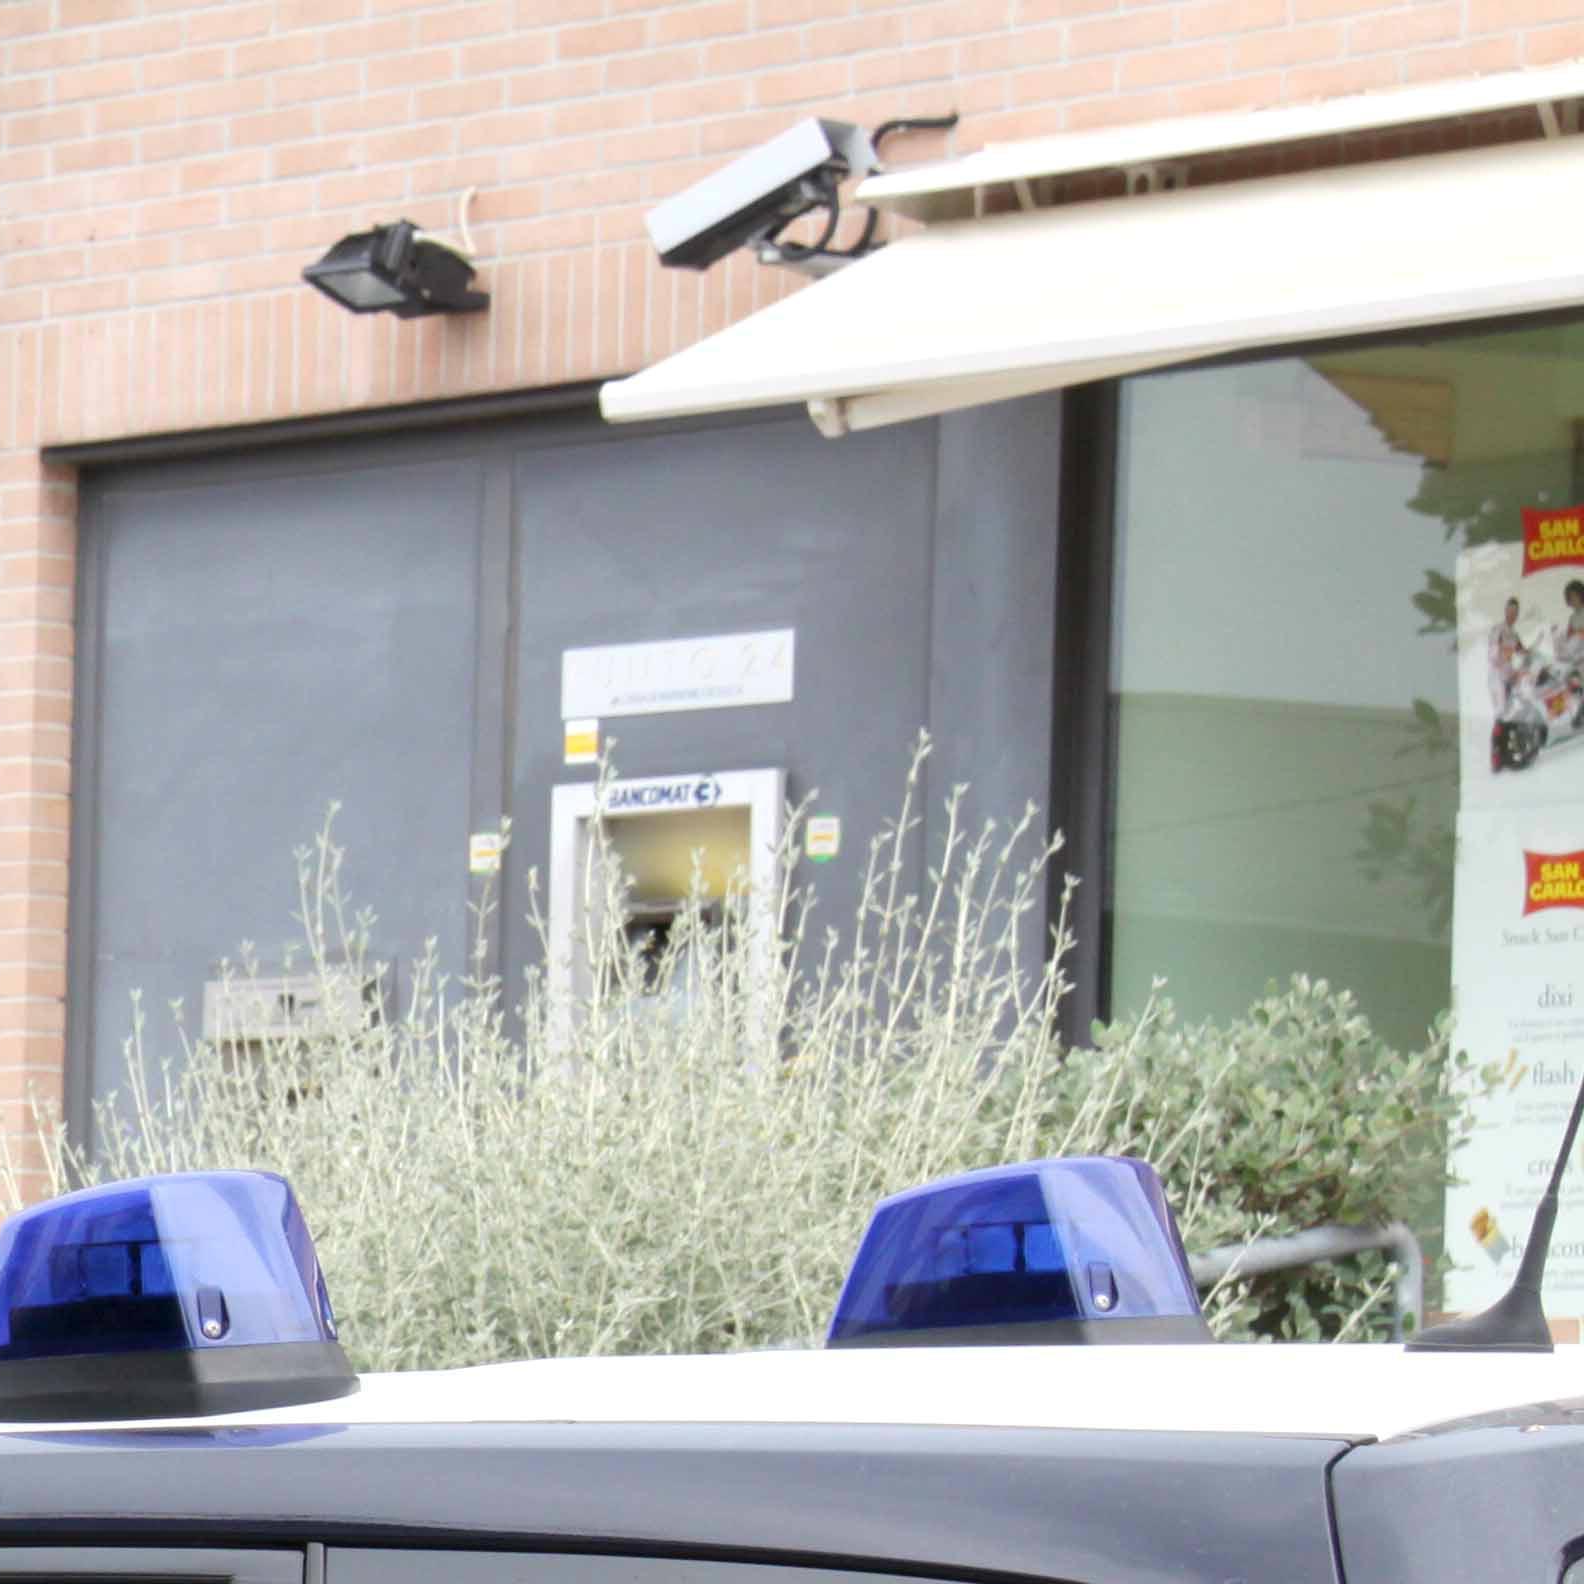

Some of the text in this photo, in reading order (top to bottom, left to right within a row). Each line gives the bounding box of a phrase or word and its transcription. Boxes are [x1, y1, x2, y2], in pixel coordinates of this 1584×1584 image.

[1539, 518, 1579, 539] SAN
[1540, 861, 1579, 882] SAN
[1537, 984, 1573, 1010] dixi
[1533, 1058, 1574, 1086] flash
